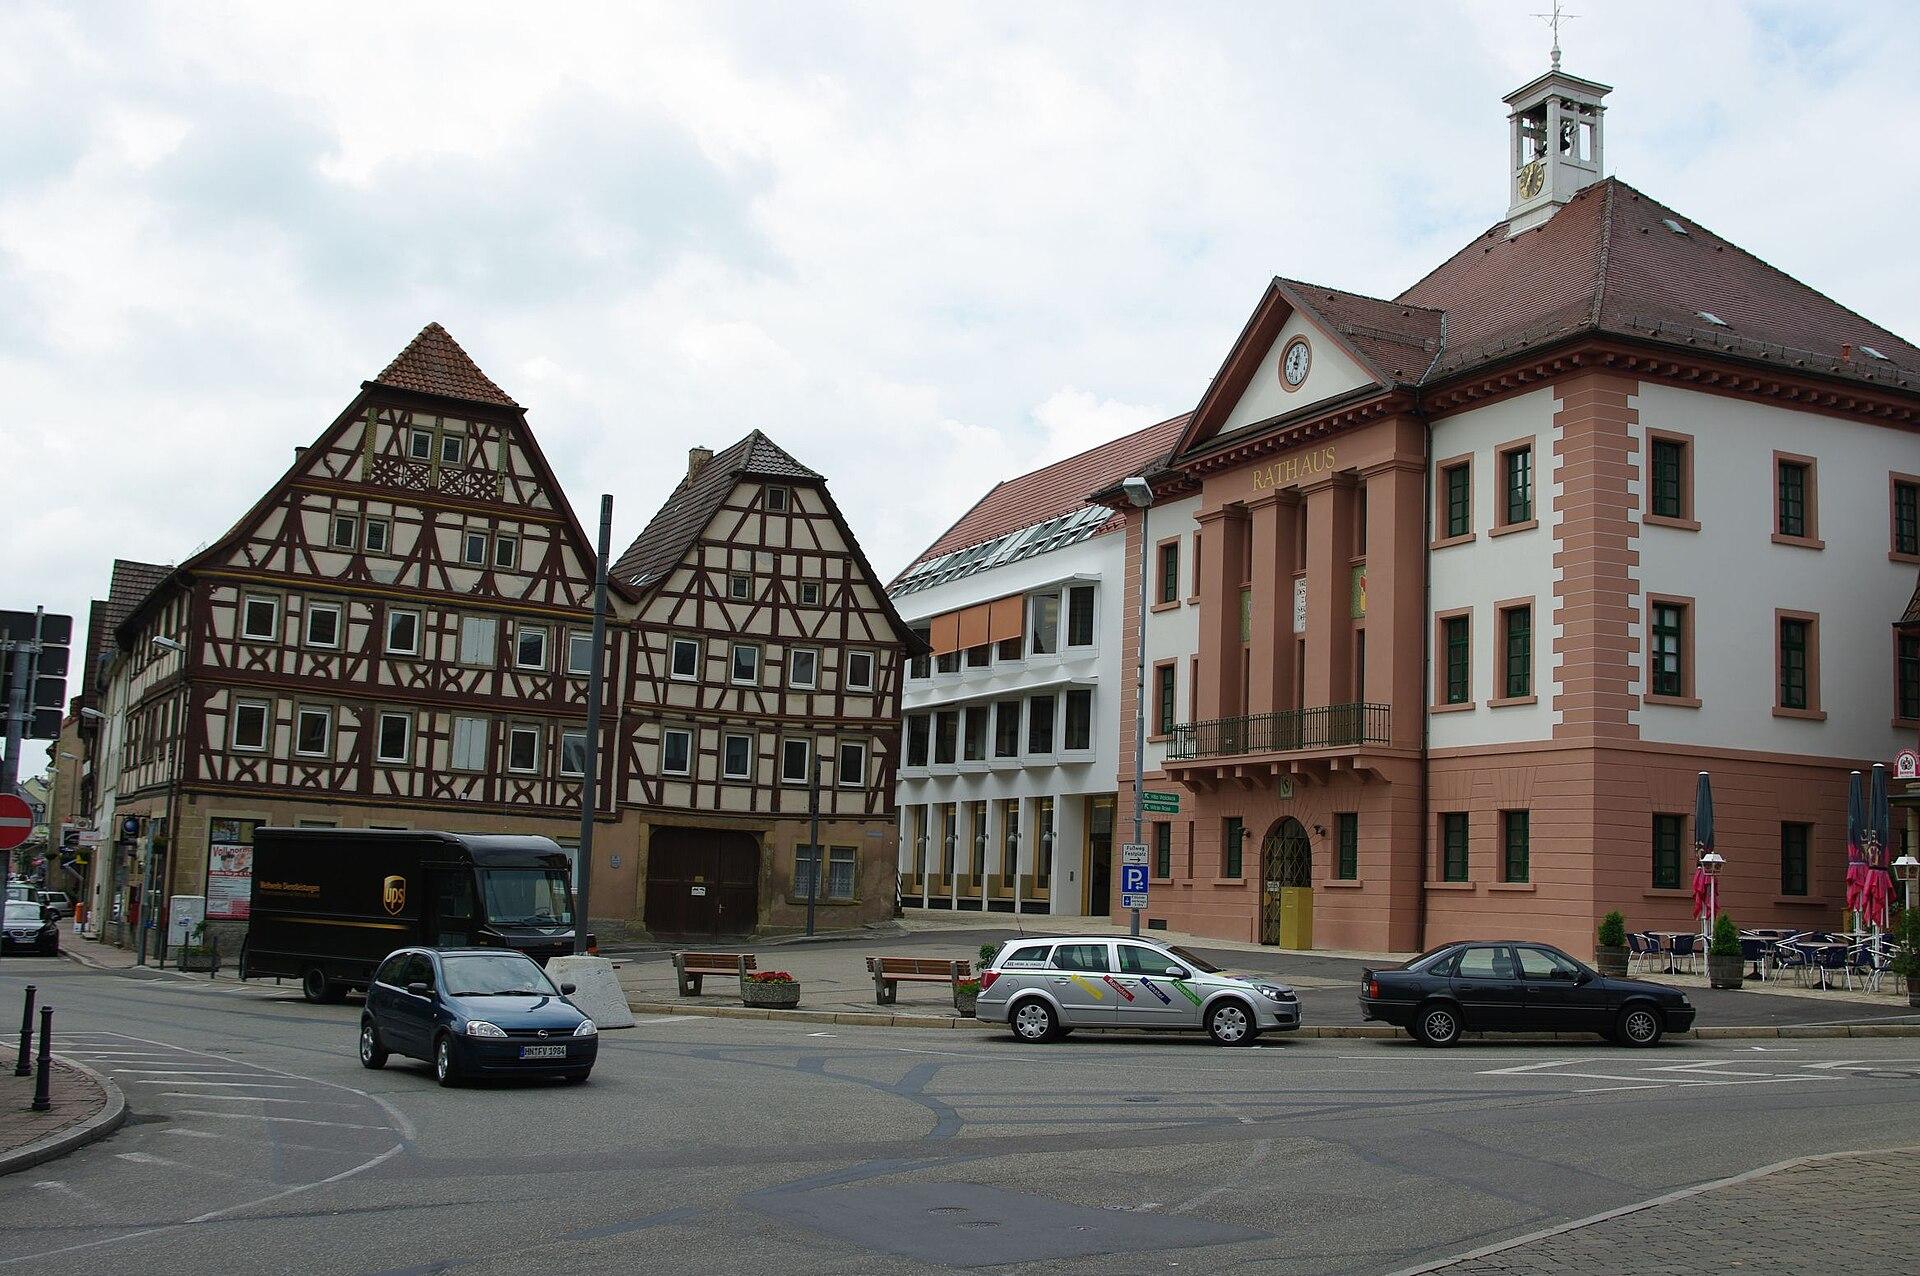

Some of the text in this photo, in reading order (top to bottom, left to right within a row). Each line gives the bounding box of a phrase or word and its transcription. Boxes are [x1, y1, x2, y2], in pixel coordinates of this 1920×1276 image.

[1252, 446, 1336, 492] RATHAUS
[1128, 869, 1143, 890] P
[1107, 977, 1130, 999] Rolladen
[1146, 981, 1165, 1000] Fenster
